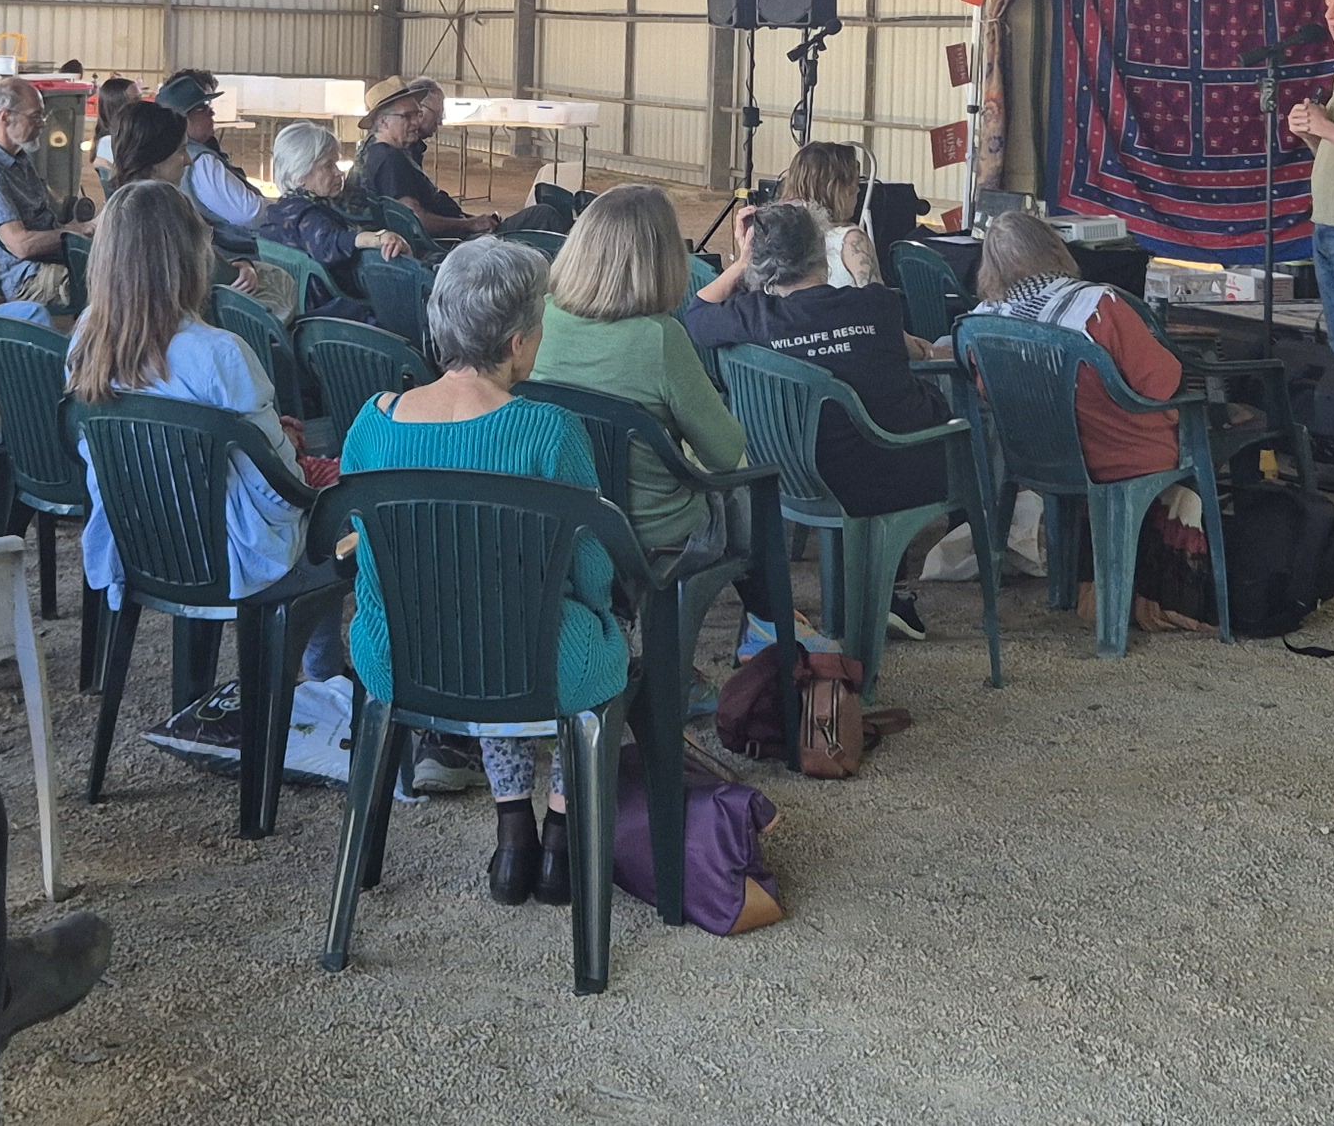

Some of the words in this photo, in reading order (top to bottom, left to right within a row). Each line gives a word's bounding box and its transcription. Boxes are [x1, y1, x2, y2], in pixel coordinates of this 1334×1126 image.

[946, 128, 956, 161] HUSK
[771, 331, 829, 349] WILDLIFE
[832, 325, 876, 339] RESCUE
[818, 342, 852, 355] CARE
